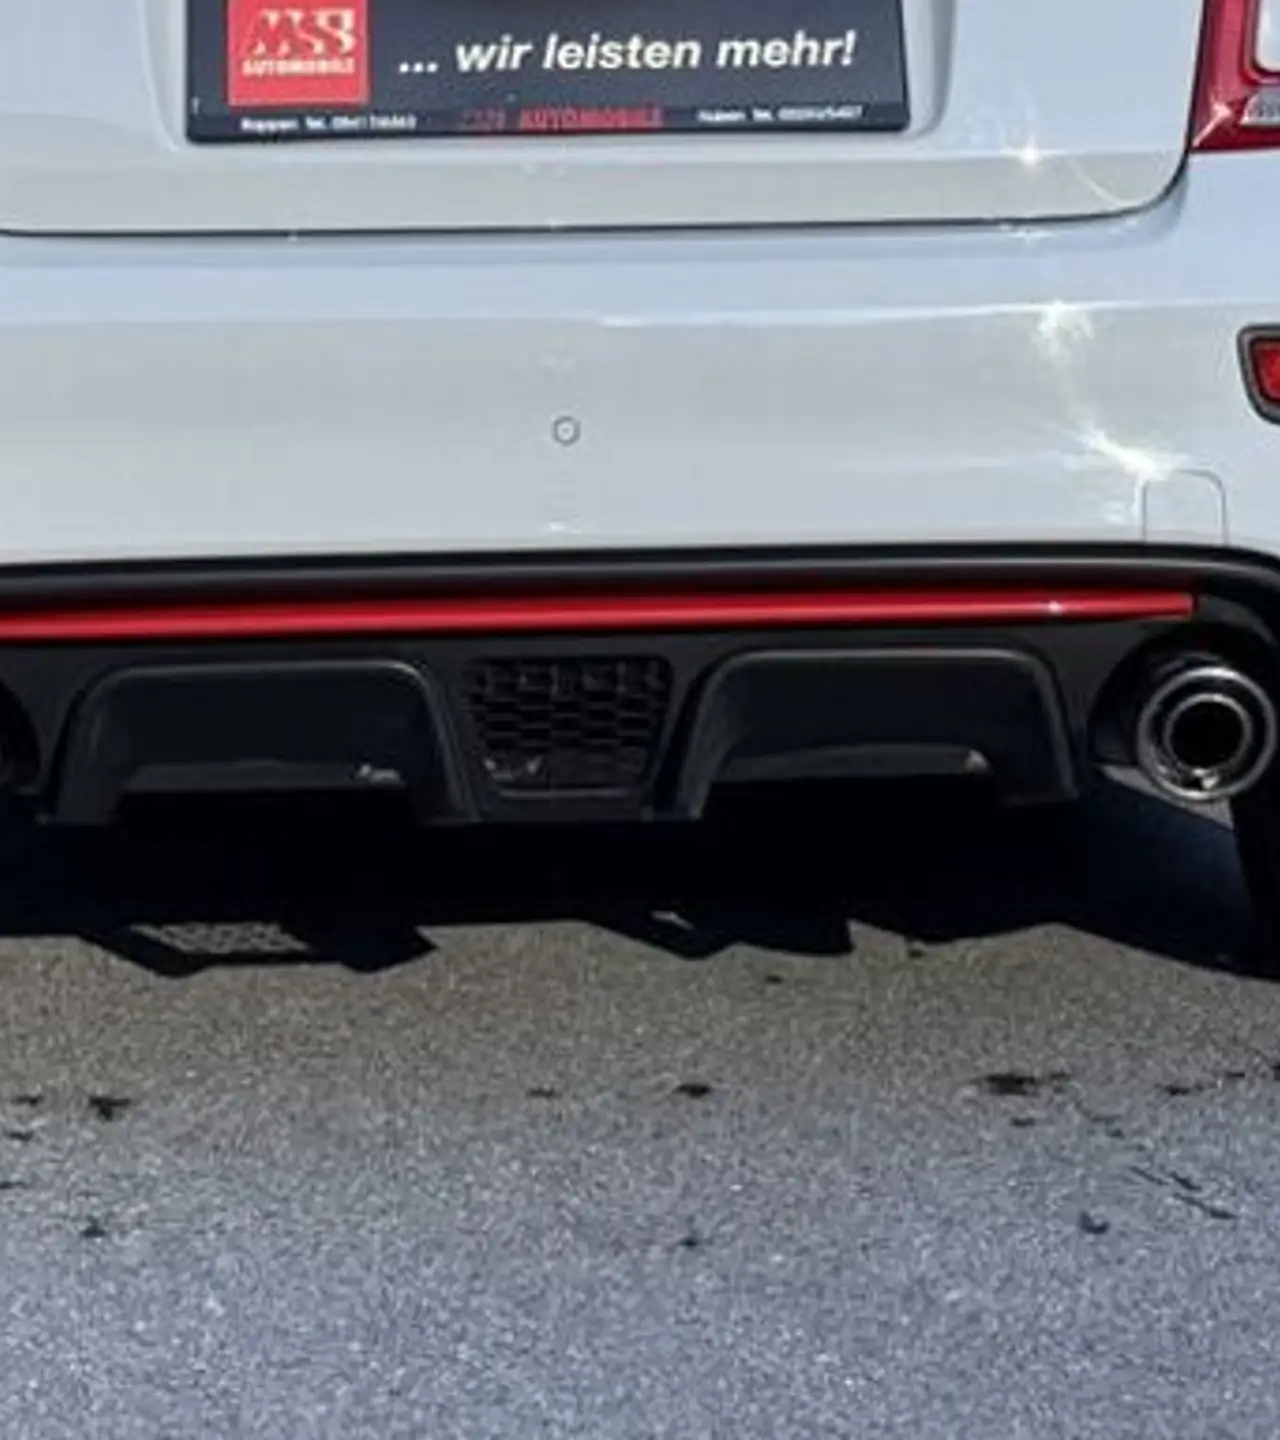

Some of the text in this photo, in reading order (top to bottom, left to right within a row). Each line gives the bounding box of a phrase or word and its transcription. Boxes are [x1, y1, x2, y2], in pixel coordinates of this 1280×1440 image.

[455, 33, 533, 73] wir
[541, 31, 702, 70] leisten
[715, 28, 857, 68] mehr!
